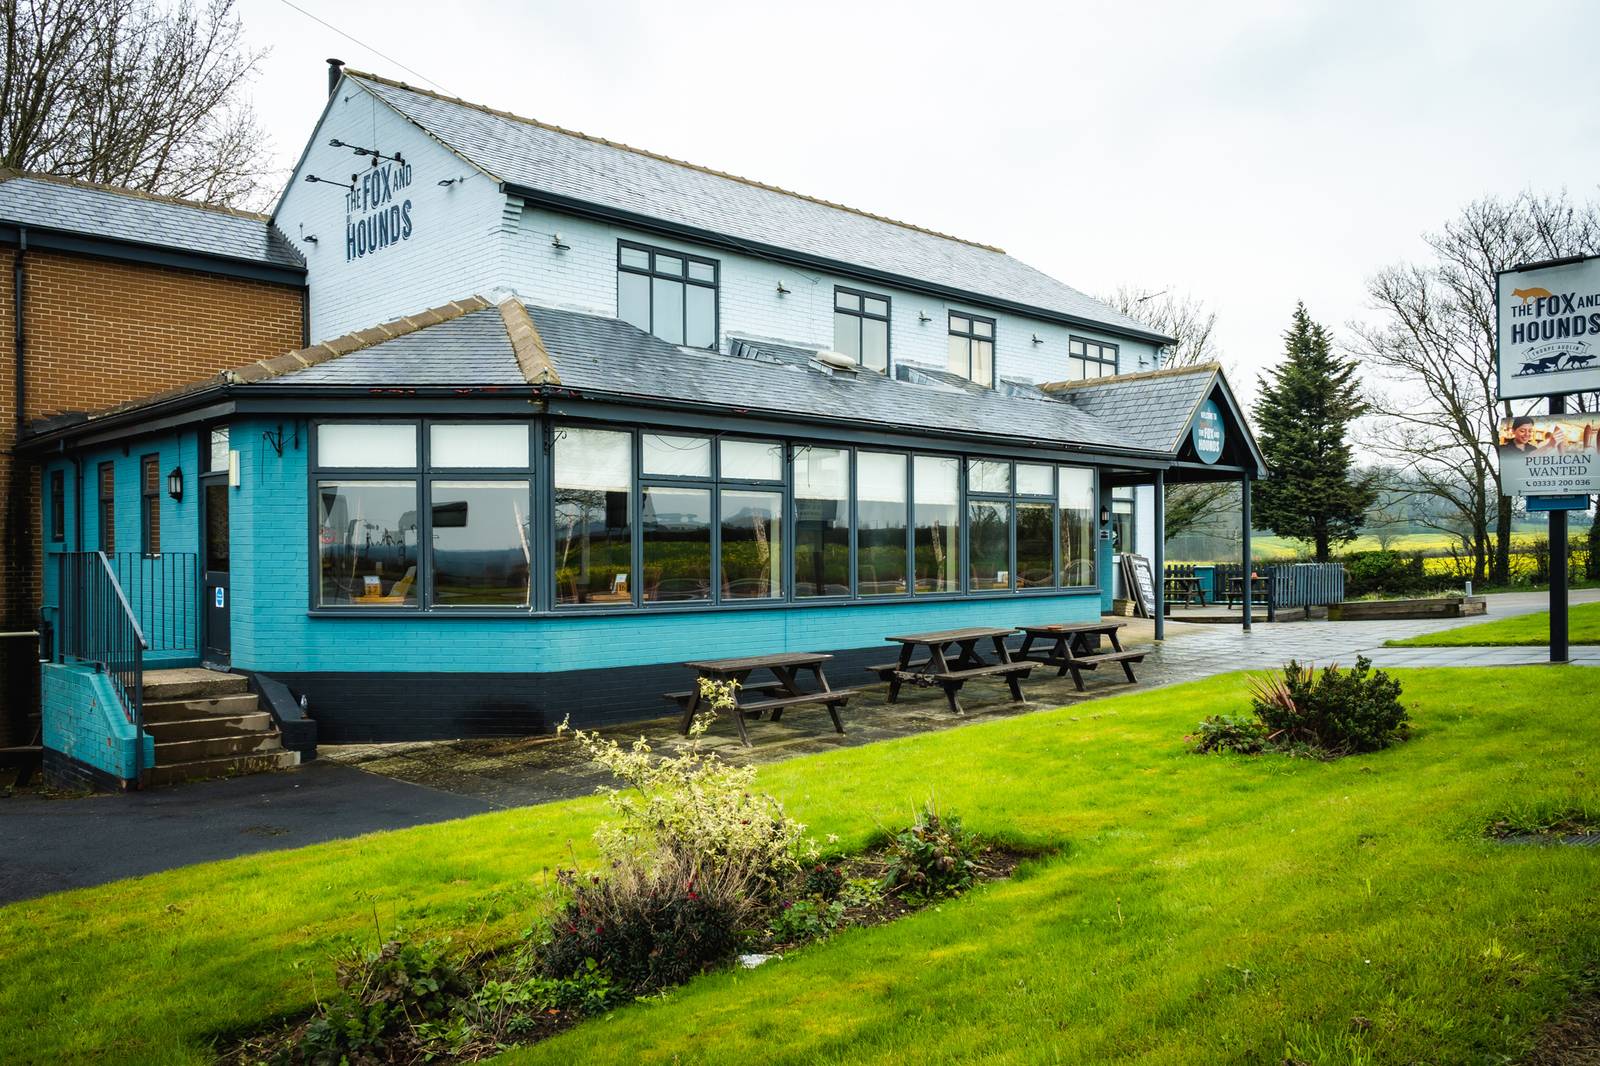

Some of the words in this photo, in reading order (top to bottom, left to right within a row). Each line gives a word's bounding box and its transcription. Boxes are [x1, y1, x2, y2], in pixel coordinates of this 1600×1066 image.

[345, 188, 361, 214] THE
[363, 163, 392, 213] FOX
[393, 164, 412, 192] AND
[346, 199, 412, 263] HOUNDS
[1511, 304, 1533, 317] THE
[1536, 292, 1576, 318] FOX
[1577, 294, 1600, 309] AND
[1511, 313, 1600, 345] HOUNDS
[1532, 345, 1555, 357] THORPE
[1204, 427, 1214, 440] FOX
[1198, 438, 1220, 453] HOUNDS
[1525, 454, 1591, 466] PUBLICAN
[1529, 466, 1587, 477] WANTED
[1558, 479, 1573, 487] 200
